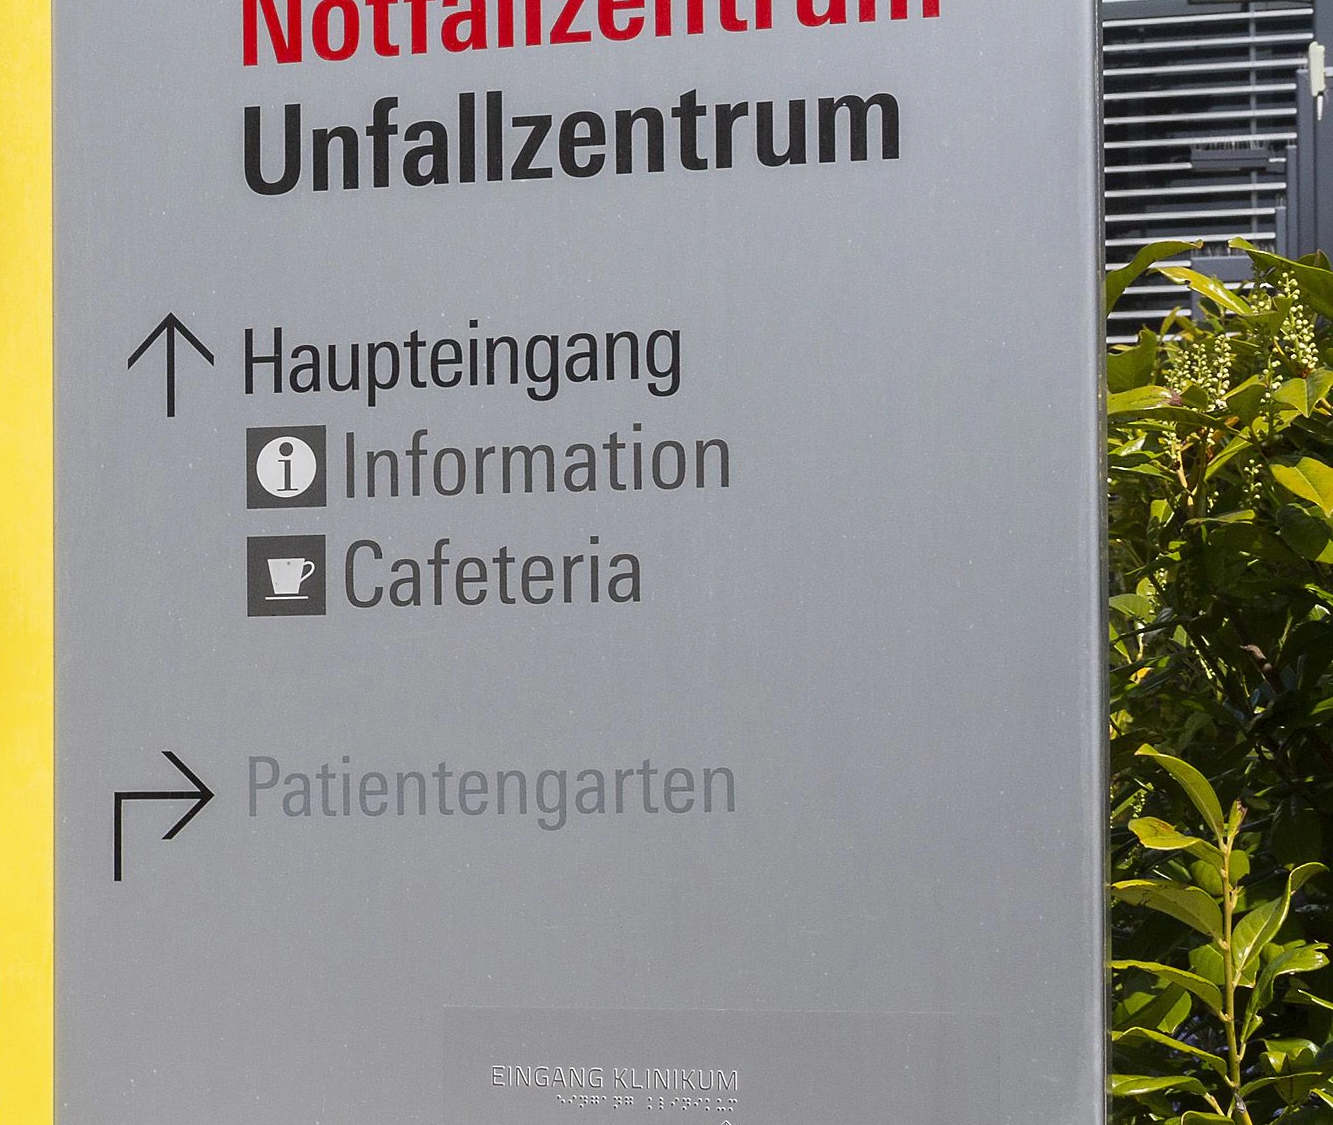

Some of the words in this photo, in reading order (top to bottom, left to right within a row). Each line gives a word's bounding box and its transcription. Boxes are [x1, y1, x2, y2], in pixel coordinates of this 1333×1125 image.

[242, 88, 900, 197] Unfallzentrum
[244, 320, 682, 406] Haupteingang
[344, 423, 731, 499] Information
[343, 536, 642, 609] Cafeteria
[246, 755, 736, 832] Patientengarten
[491, 1065, 605, 1089] EINGANG
[612, 1067, 739, 1092] KLINIKUM
